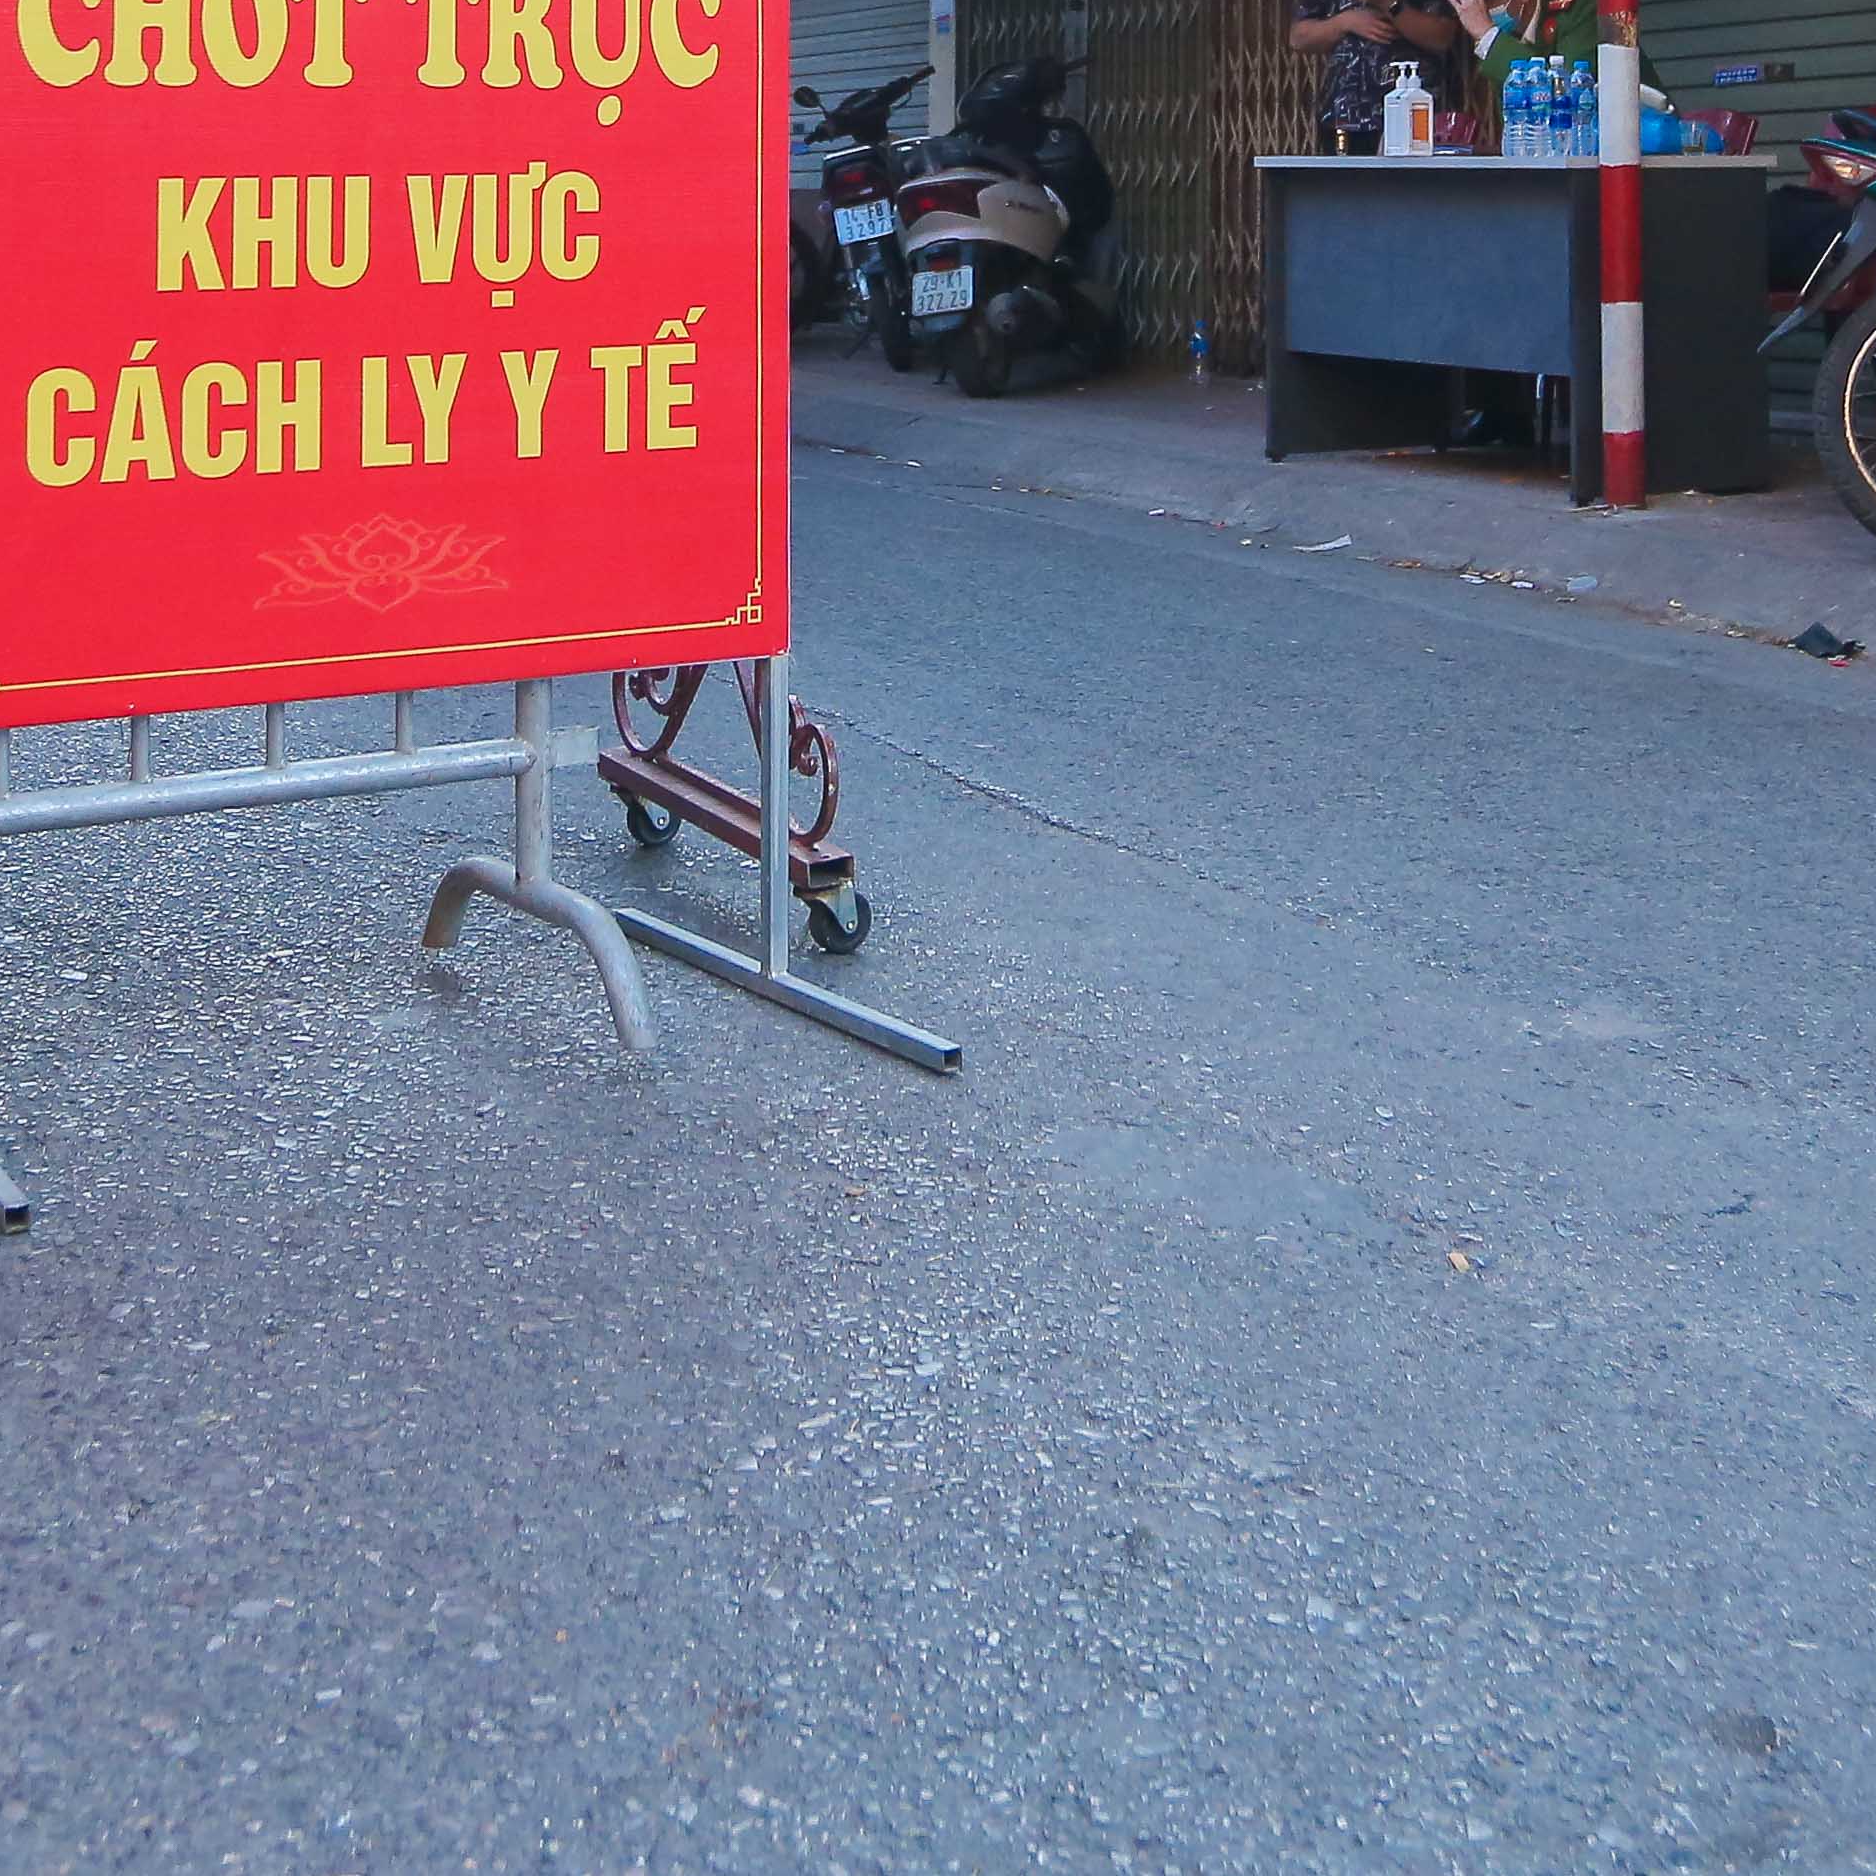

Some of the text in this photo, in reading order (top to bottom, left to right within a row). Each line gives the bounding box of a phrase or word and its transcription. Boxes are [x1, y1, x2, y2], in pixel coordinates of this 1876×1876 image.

[156, 161, 601, 308] KHU VỰC
[25, 307, 707, 488] CÁCH LY Y TẾ
